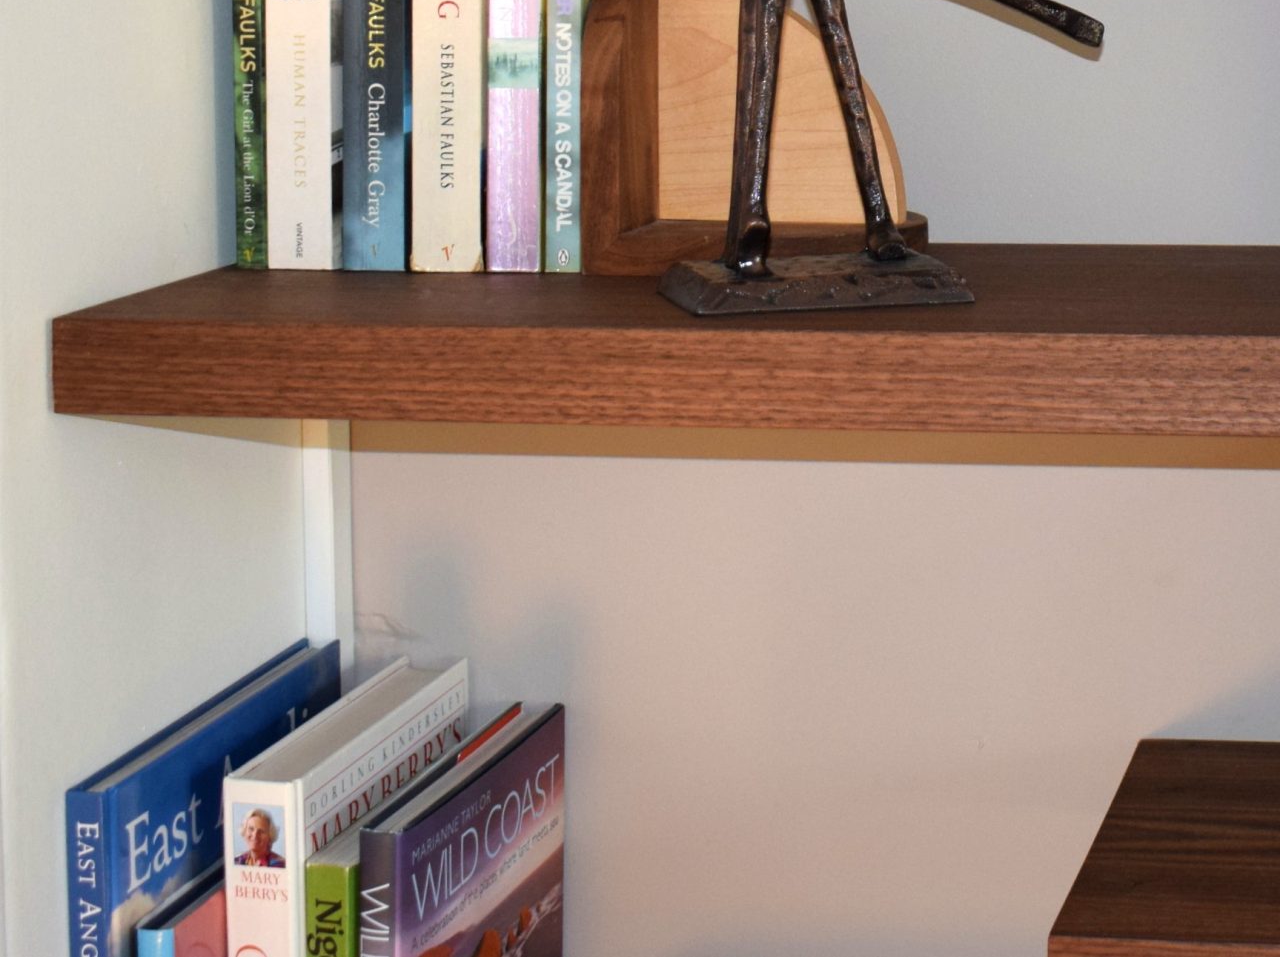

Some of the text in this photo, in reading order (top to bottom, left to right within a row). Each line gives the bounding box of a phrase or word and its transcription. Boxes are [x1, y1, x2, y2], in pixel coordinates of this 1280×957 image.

[293, 33, 307, 109] HUMAN
[555, 23, 573, 87] NOTES
[241, 82, 254, 106] The
[439, 43, 456, 131] SEBASTIAN
[556, 89, 573, 118] ON
[241, 109, 255, 132] Girl
[242, 134, 252, 148] at
[366, 82, 387, 174] Charlotte
[556, 123, 572, 135] A
[242, 150, 255, 171] the
[293, 117, 307, 189] TRACES
[439, 133, 456, 190] FAULKS
[242, 174, 255, 203] Lion
[361, 179, 386, 229] Gray
[555, 140, 574, 232] SCANDAL
[242, 206, 256, 237] d'Or
[295, 222, 304, 259] VINTAGE
[310, 759, 375, 817] DORLING
[381, 690, 463, 761] KINDERSLEY
[310, 789, 375, 853] MARY
[380, 716, 462, 801] BERRY'S
[76, 821, 100, 888] EAST
[125, 793, 204, 894] East
[411, 753, 560, 922] WILD COAST
[235, 885, 289, 902] BERRY'S
[240, 870, 281, 886] MARY
